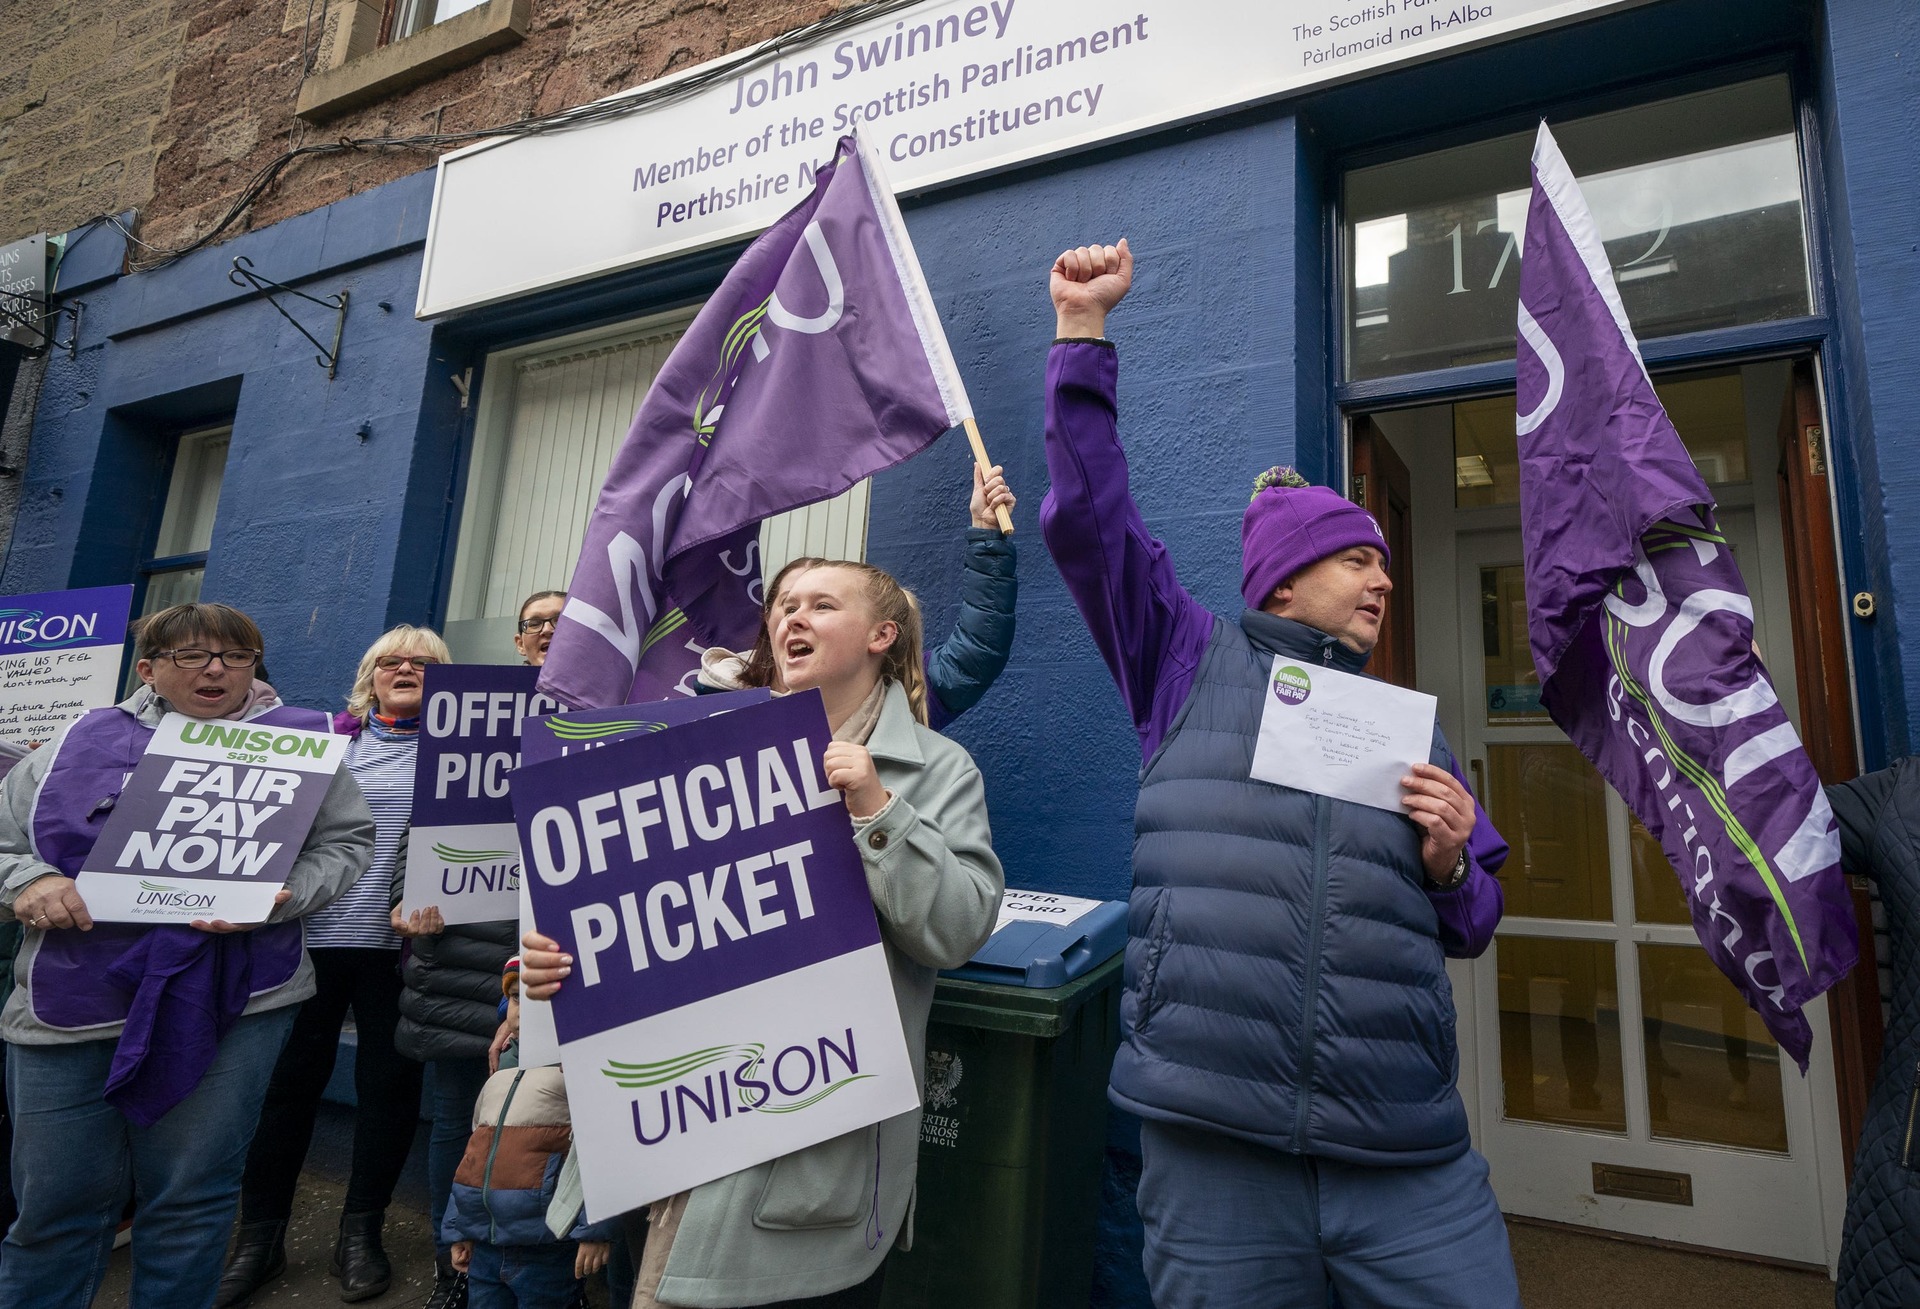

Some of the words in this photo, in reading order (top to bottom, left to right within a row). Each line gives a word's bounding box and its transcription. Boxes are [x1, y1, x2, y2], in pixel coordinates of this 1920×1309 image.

[1293, 23, 1322, 42] The
[1329, 0, 1395, 32] Scottish
[1303, 26, 1392, 67] Pàrlamaid
[1400, 24, 1423, 41] na
[1431, 4, 1492, 32] h-Alba
[730, 61, 818, 115] John
[832, 0, 1015, 80] Swinney
[632, 135, 739, 192] Member
[744, 122, 775, 159] of
[778, 116, 824, 147] the
[832, 72, 950, 132] Scottish
[961, 12, 1149, 95] Parliament
[656, 171, 789, 228] Perthshire
[889, 83, 1104, 163] Constituency
[0, 612, 98, 645] ISON
[34, 656, 51, 667] US
[56, 652, 92, 665] FEEL
[3, 679, 33, 688] don't
[35, 676, 68, 686] match
[69, 674, 93, 687] your
[1279, 671, 1309, 688] UNISON
[1276, 686, 1292, 697] FAIR
[1292, 691, 1306, 701] PAY
[8, 703, 46, 715] future
[47, 700, 84, 713] funded
[24, 713, 67, 722] childcare
[28, 725, 55, 736] offers
[180, 721, 329, 759] UNISON
[226, 751, 268, 763] says
[158, 760, 302, 804] FAIR
[435, 752, 521, 799] PIC
[155, 796, 282, 838] PAY
[530, 737, 842, 887] OFFICIAL
[115, 831, 283, 876] NOW
[136, 891, 216, 908] UNISON
[1003, 891, 1059, 904] APER
[143, 908, 165, 916] public
[570, 839, 815, 988] PICKET
[1006, 902, 1067, 914] CARD
[631, 1027, 859, 1147] UNISON
[921, 1112, 949, 1128] ERTH
[950, 1118, 960, 1129] &
[920, 1123, 958, 1139] NROSS
[920, 1133, 956, 1148] OUNCIL
